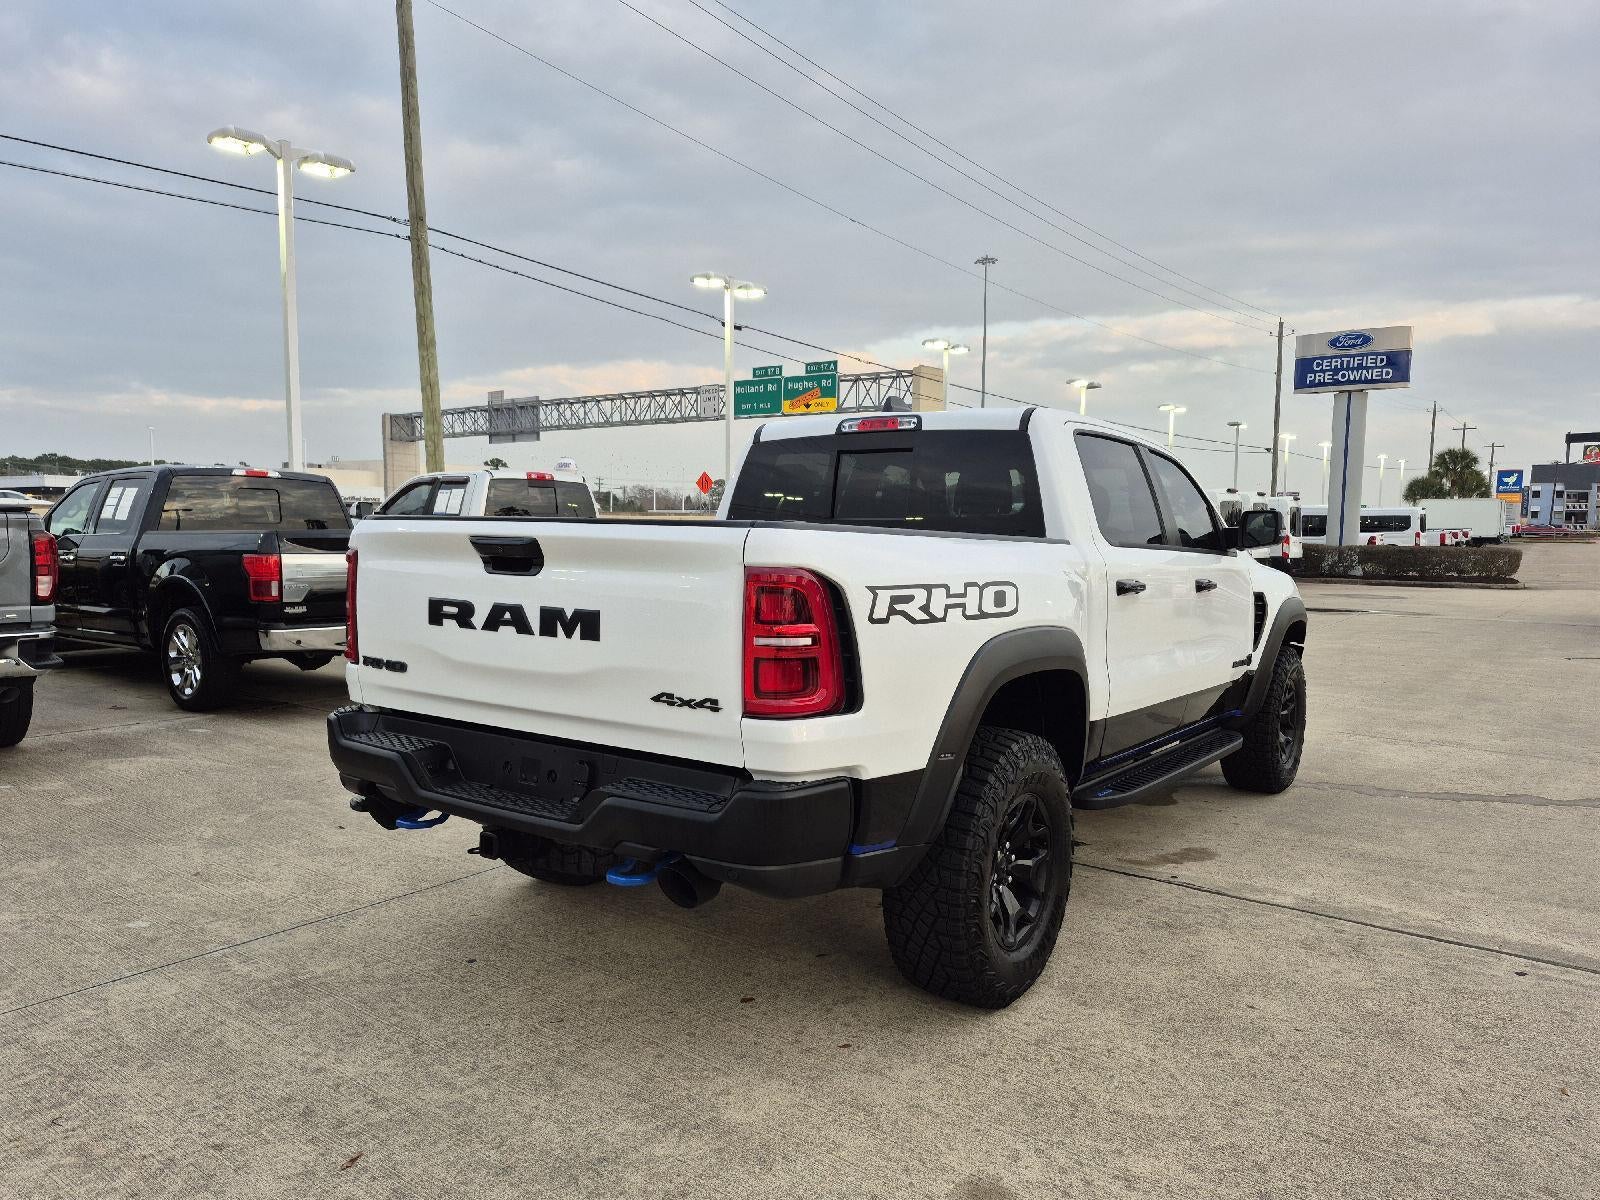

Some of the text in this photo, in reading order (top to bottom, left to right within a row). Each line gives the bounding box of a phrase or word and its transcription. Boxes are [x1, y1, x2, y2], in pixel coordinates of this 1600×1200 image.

[1336, 335, 1363, 347] Ford
[821, 363, 829, 371] 17
[830, 362, 835, 371] A
[1313, 355, 1387, 371] CERTIFIED
[767, 368, 775, 376] 17
[1306, 368, 1393, 384] PRE-OWNED
[735, 383, 777, 395] Holland Rd
[788, 378, 832, 391] Hughes Rd
[865, 580, 1020, 625] RHO
[428, 597, 601, 642] RAM
